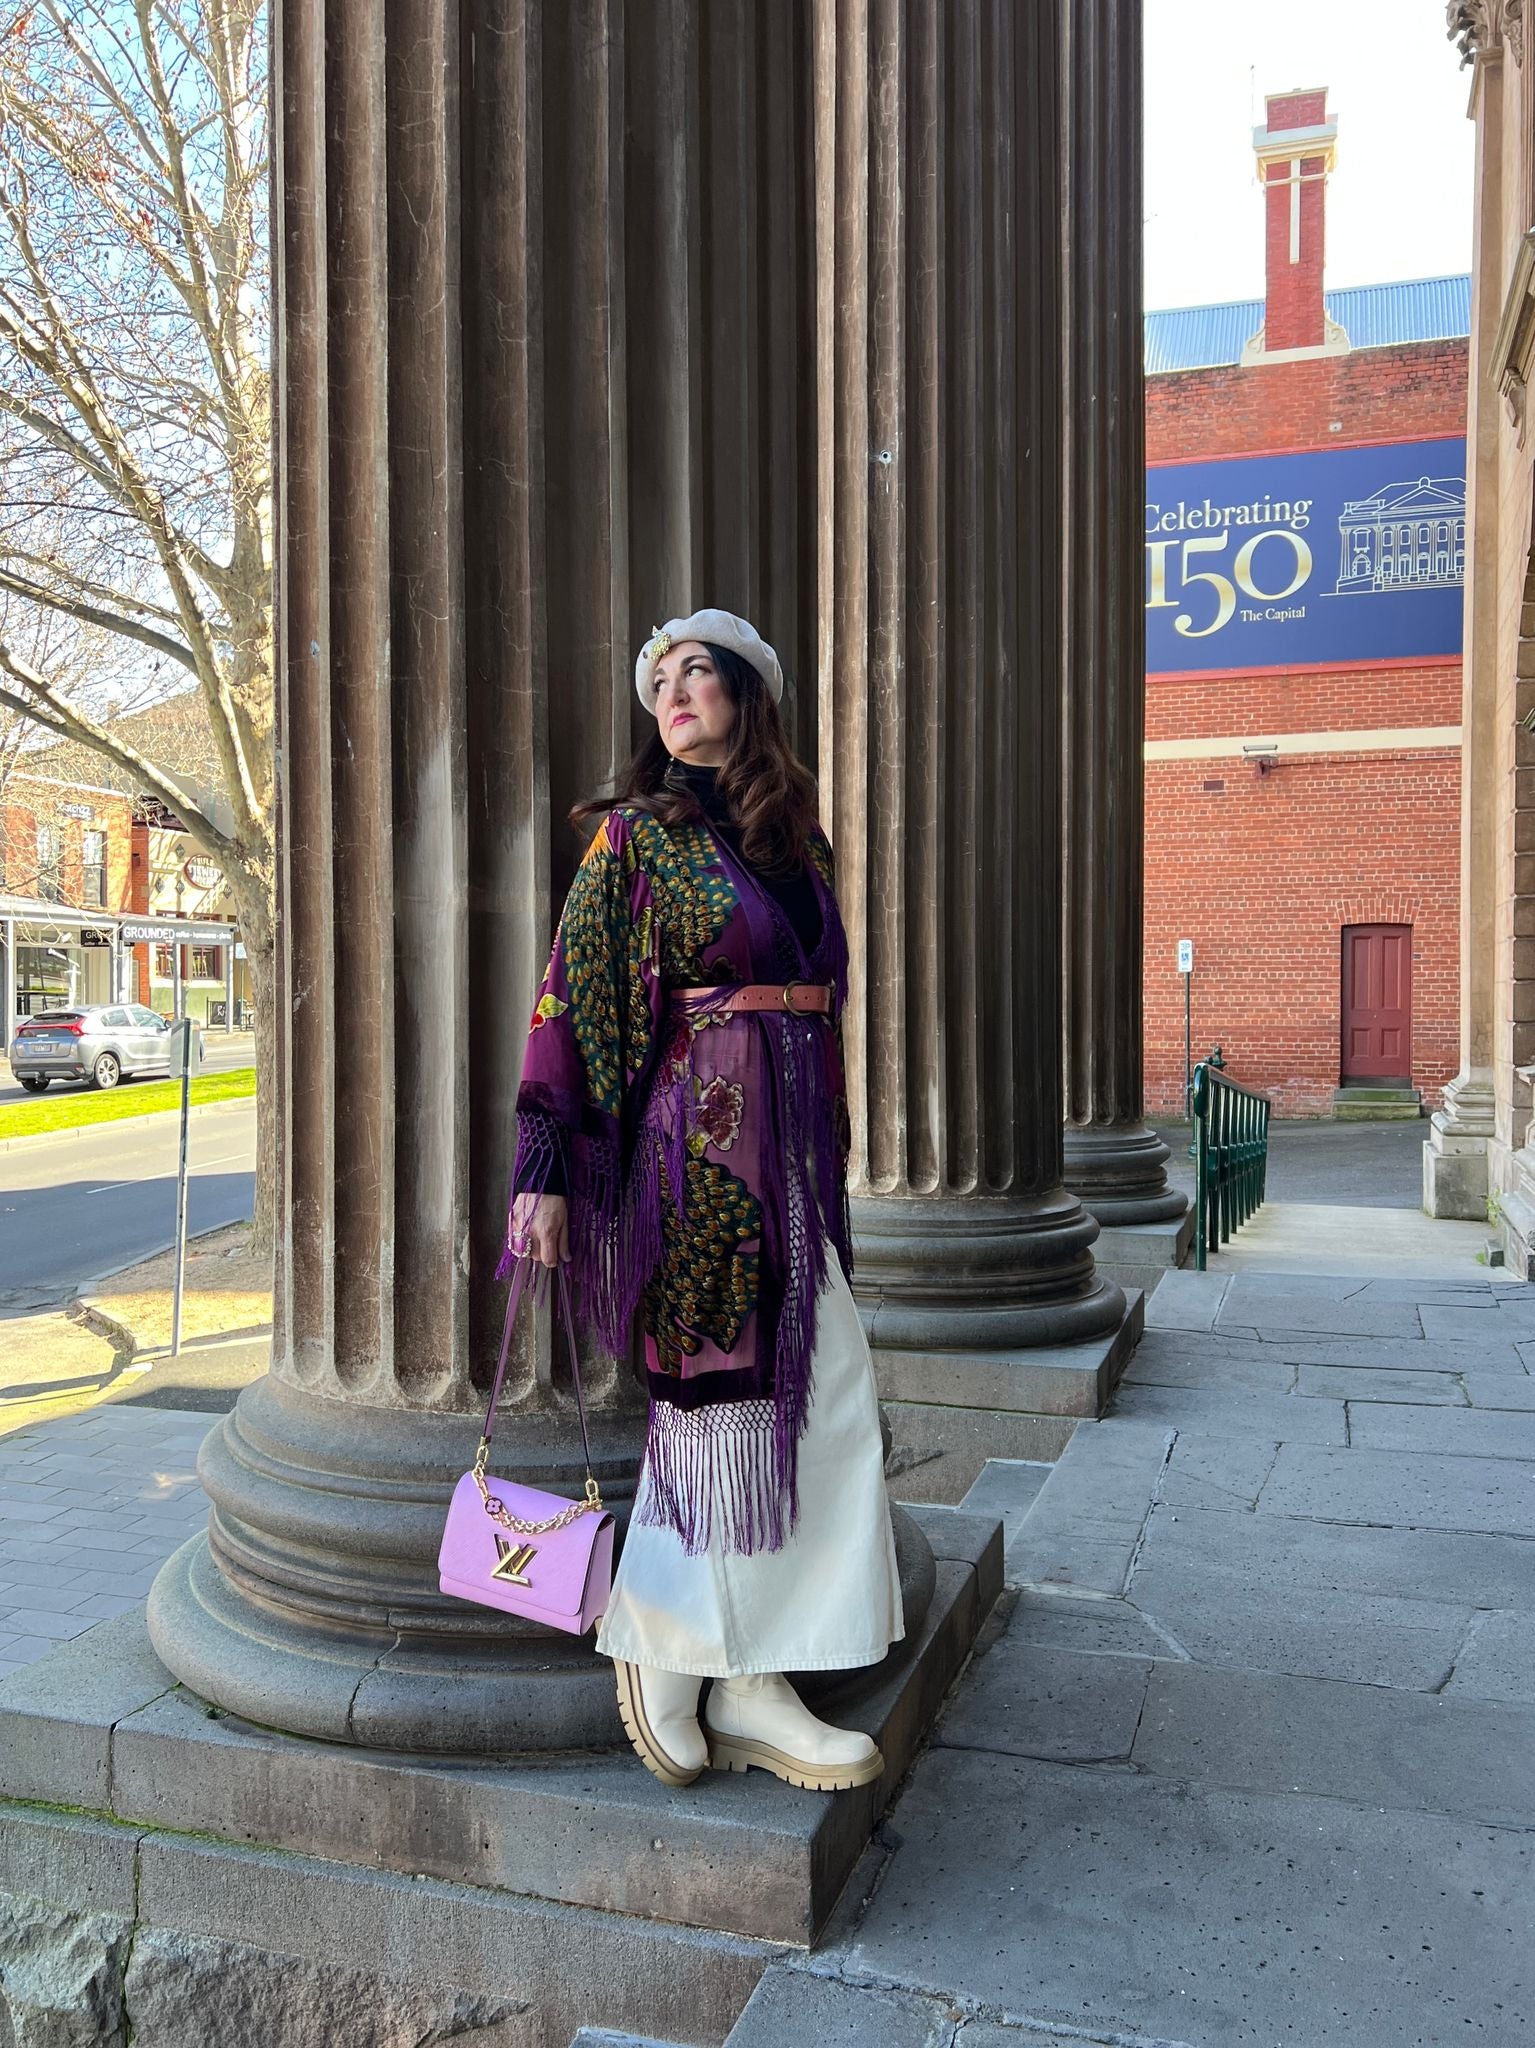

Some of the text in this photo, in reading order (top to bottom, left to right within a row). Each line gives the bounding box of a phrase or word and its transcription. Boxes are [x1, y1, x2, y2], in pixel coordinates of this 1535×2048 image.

[1145, 494, 1313, 532] Celebrating
[1145, 529, 1313, 638] 150
[1240, 606, 1306, 622] The Capital
[123, 927, 175, 940] GROUNDED
